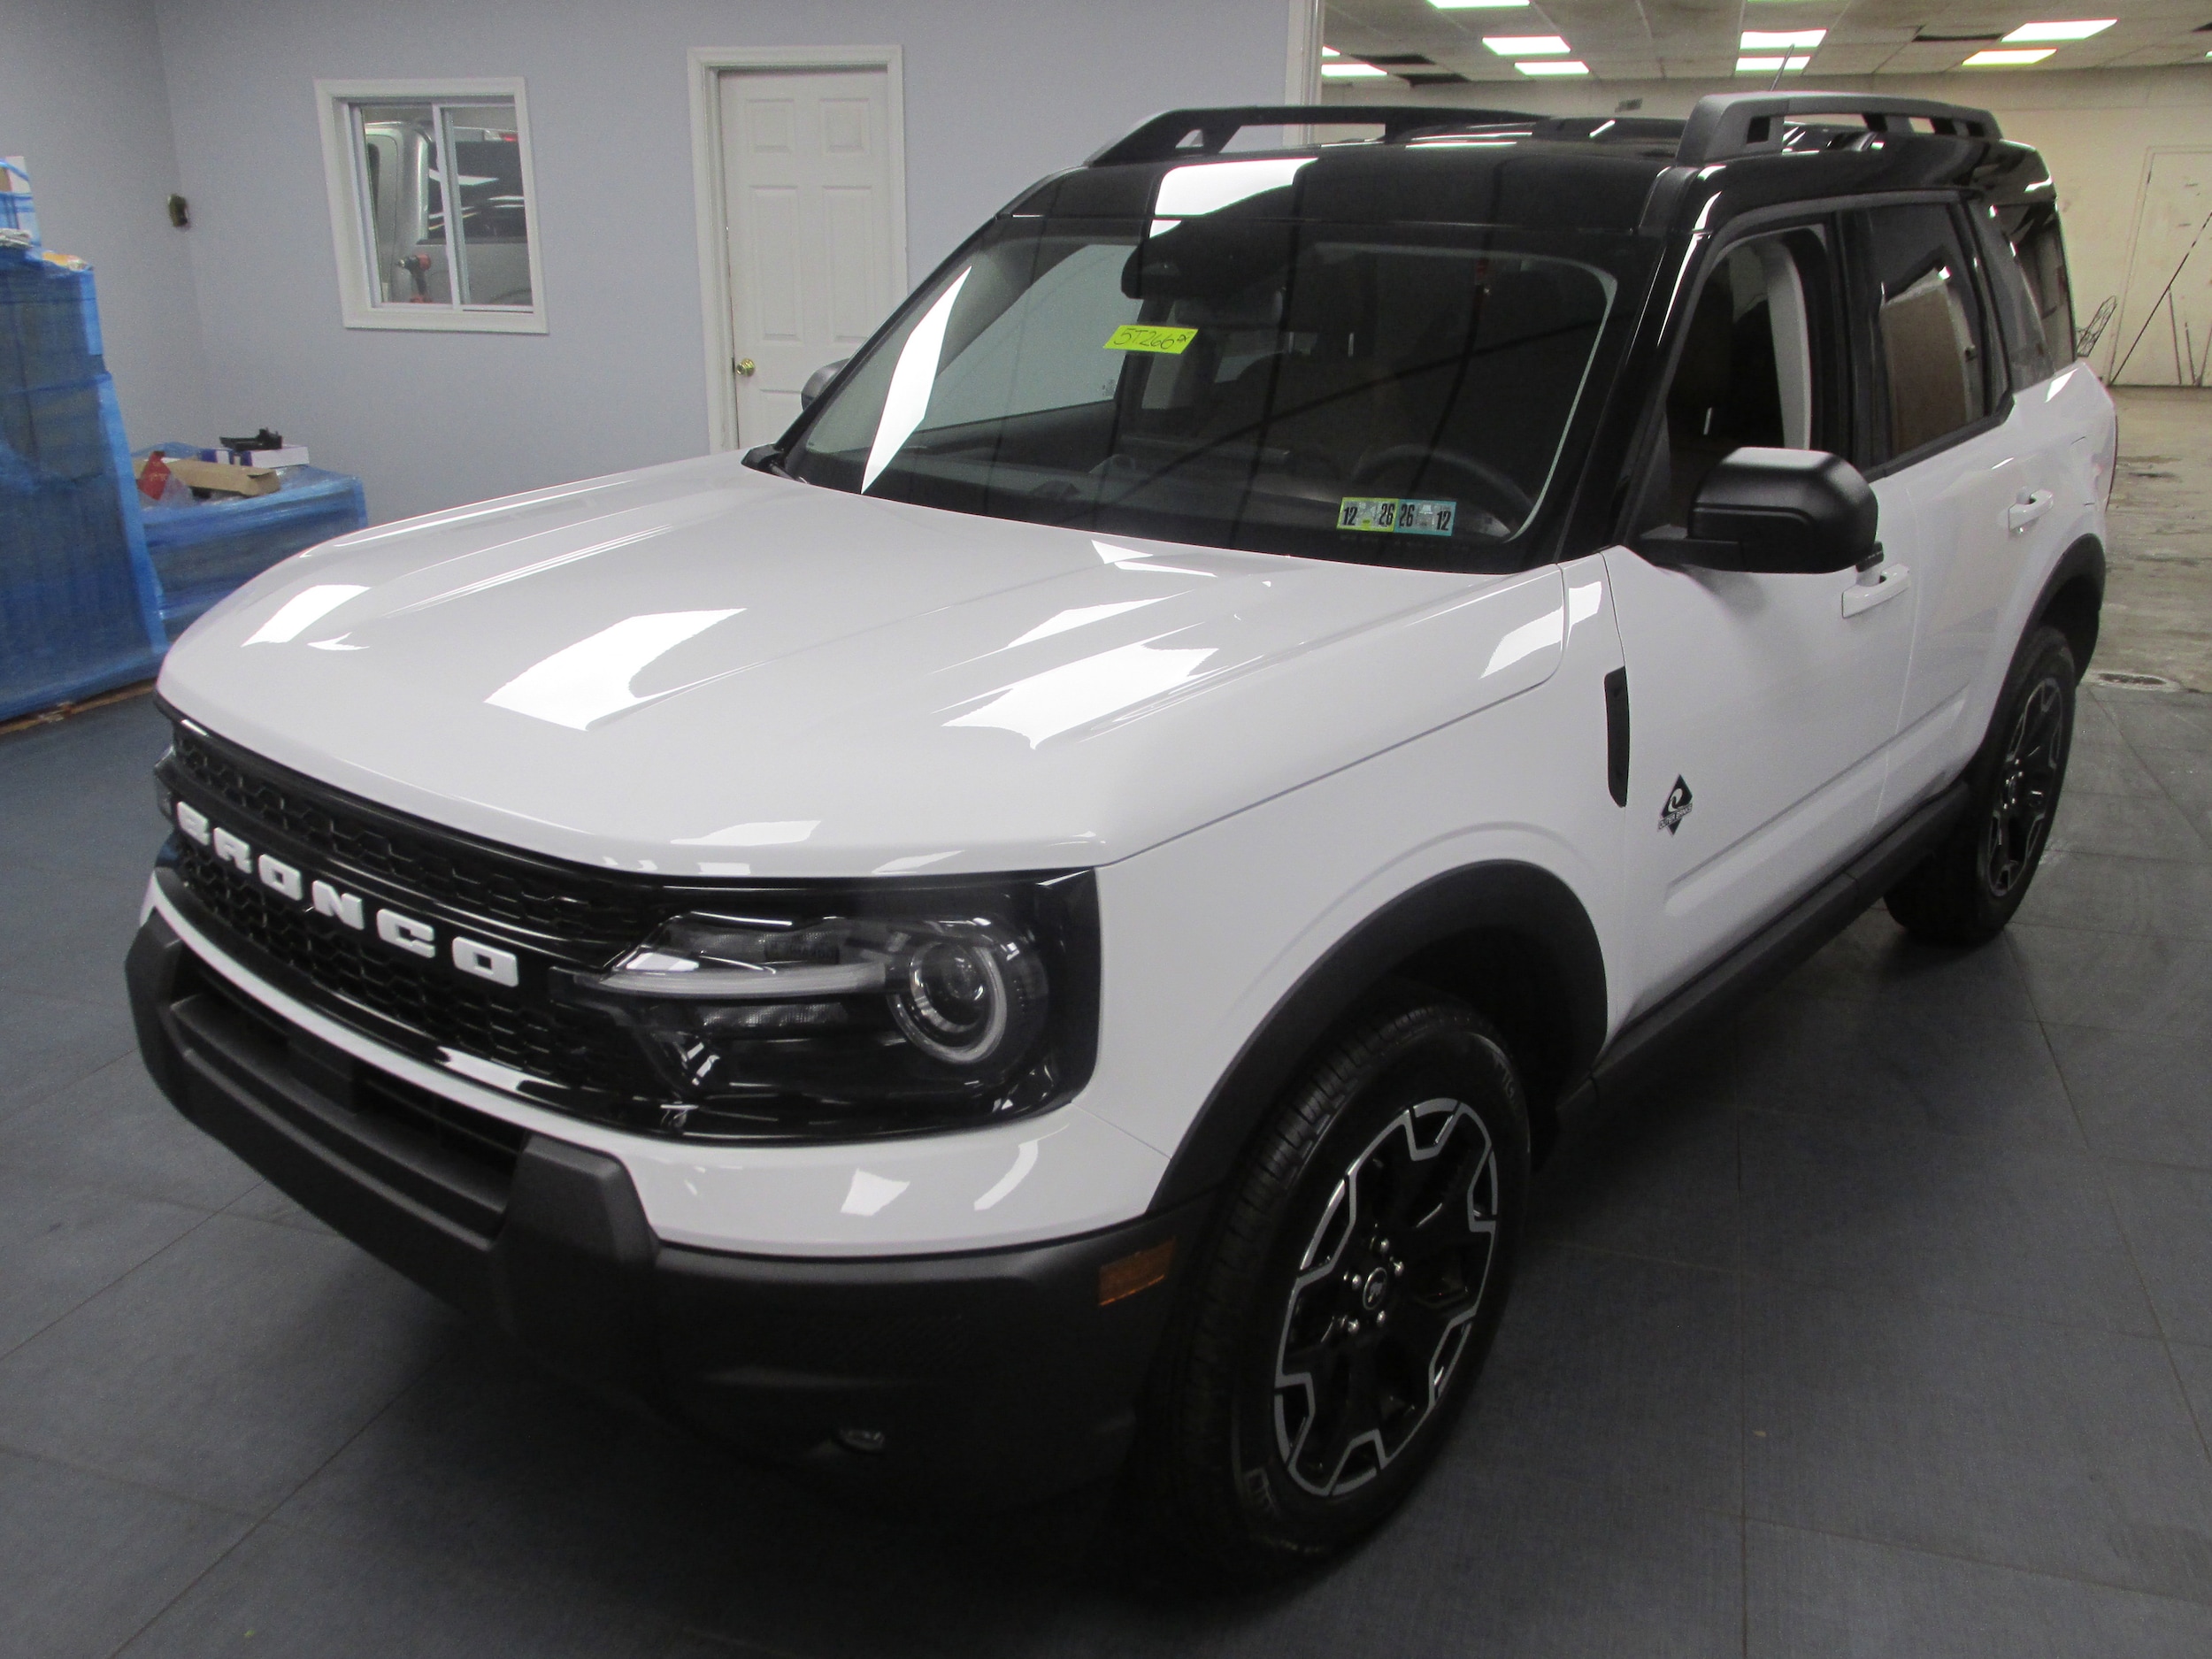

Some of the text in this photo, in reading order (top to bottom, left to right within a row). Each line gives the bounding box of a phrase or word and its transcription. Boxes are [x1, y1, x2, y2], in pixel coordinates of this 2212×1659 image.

[1343, 503, 1395, 526] 12 26
[1399, 503, 1452, 531] 26 12
[178, 801, 518, 987] BRONCO
